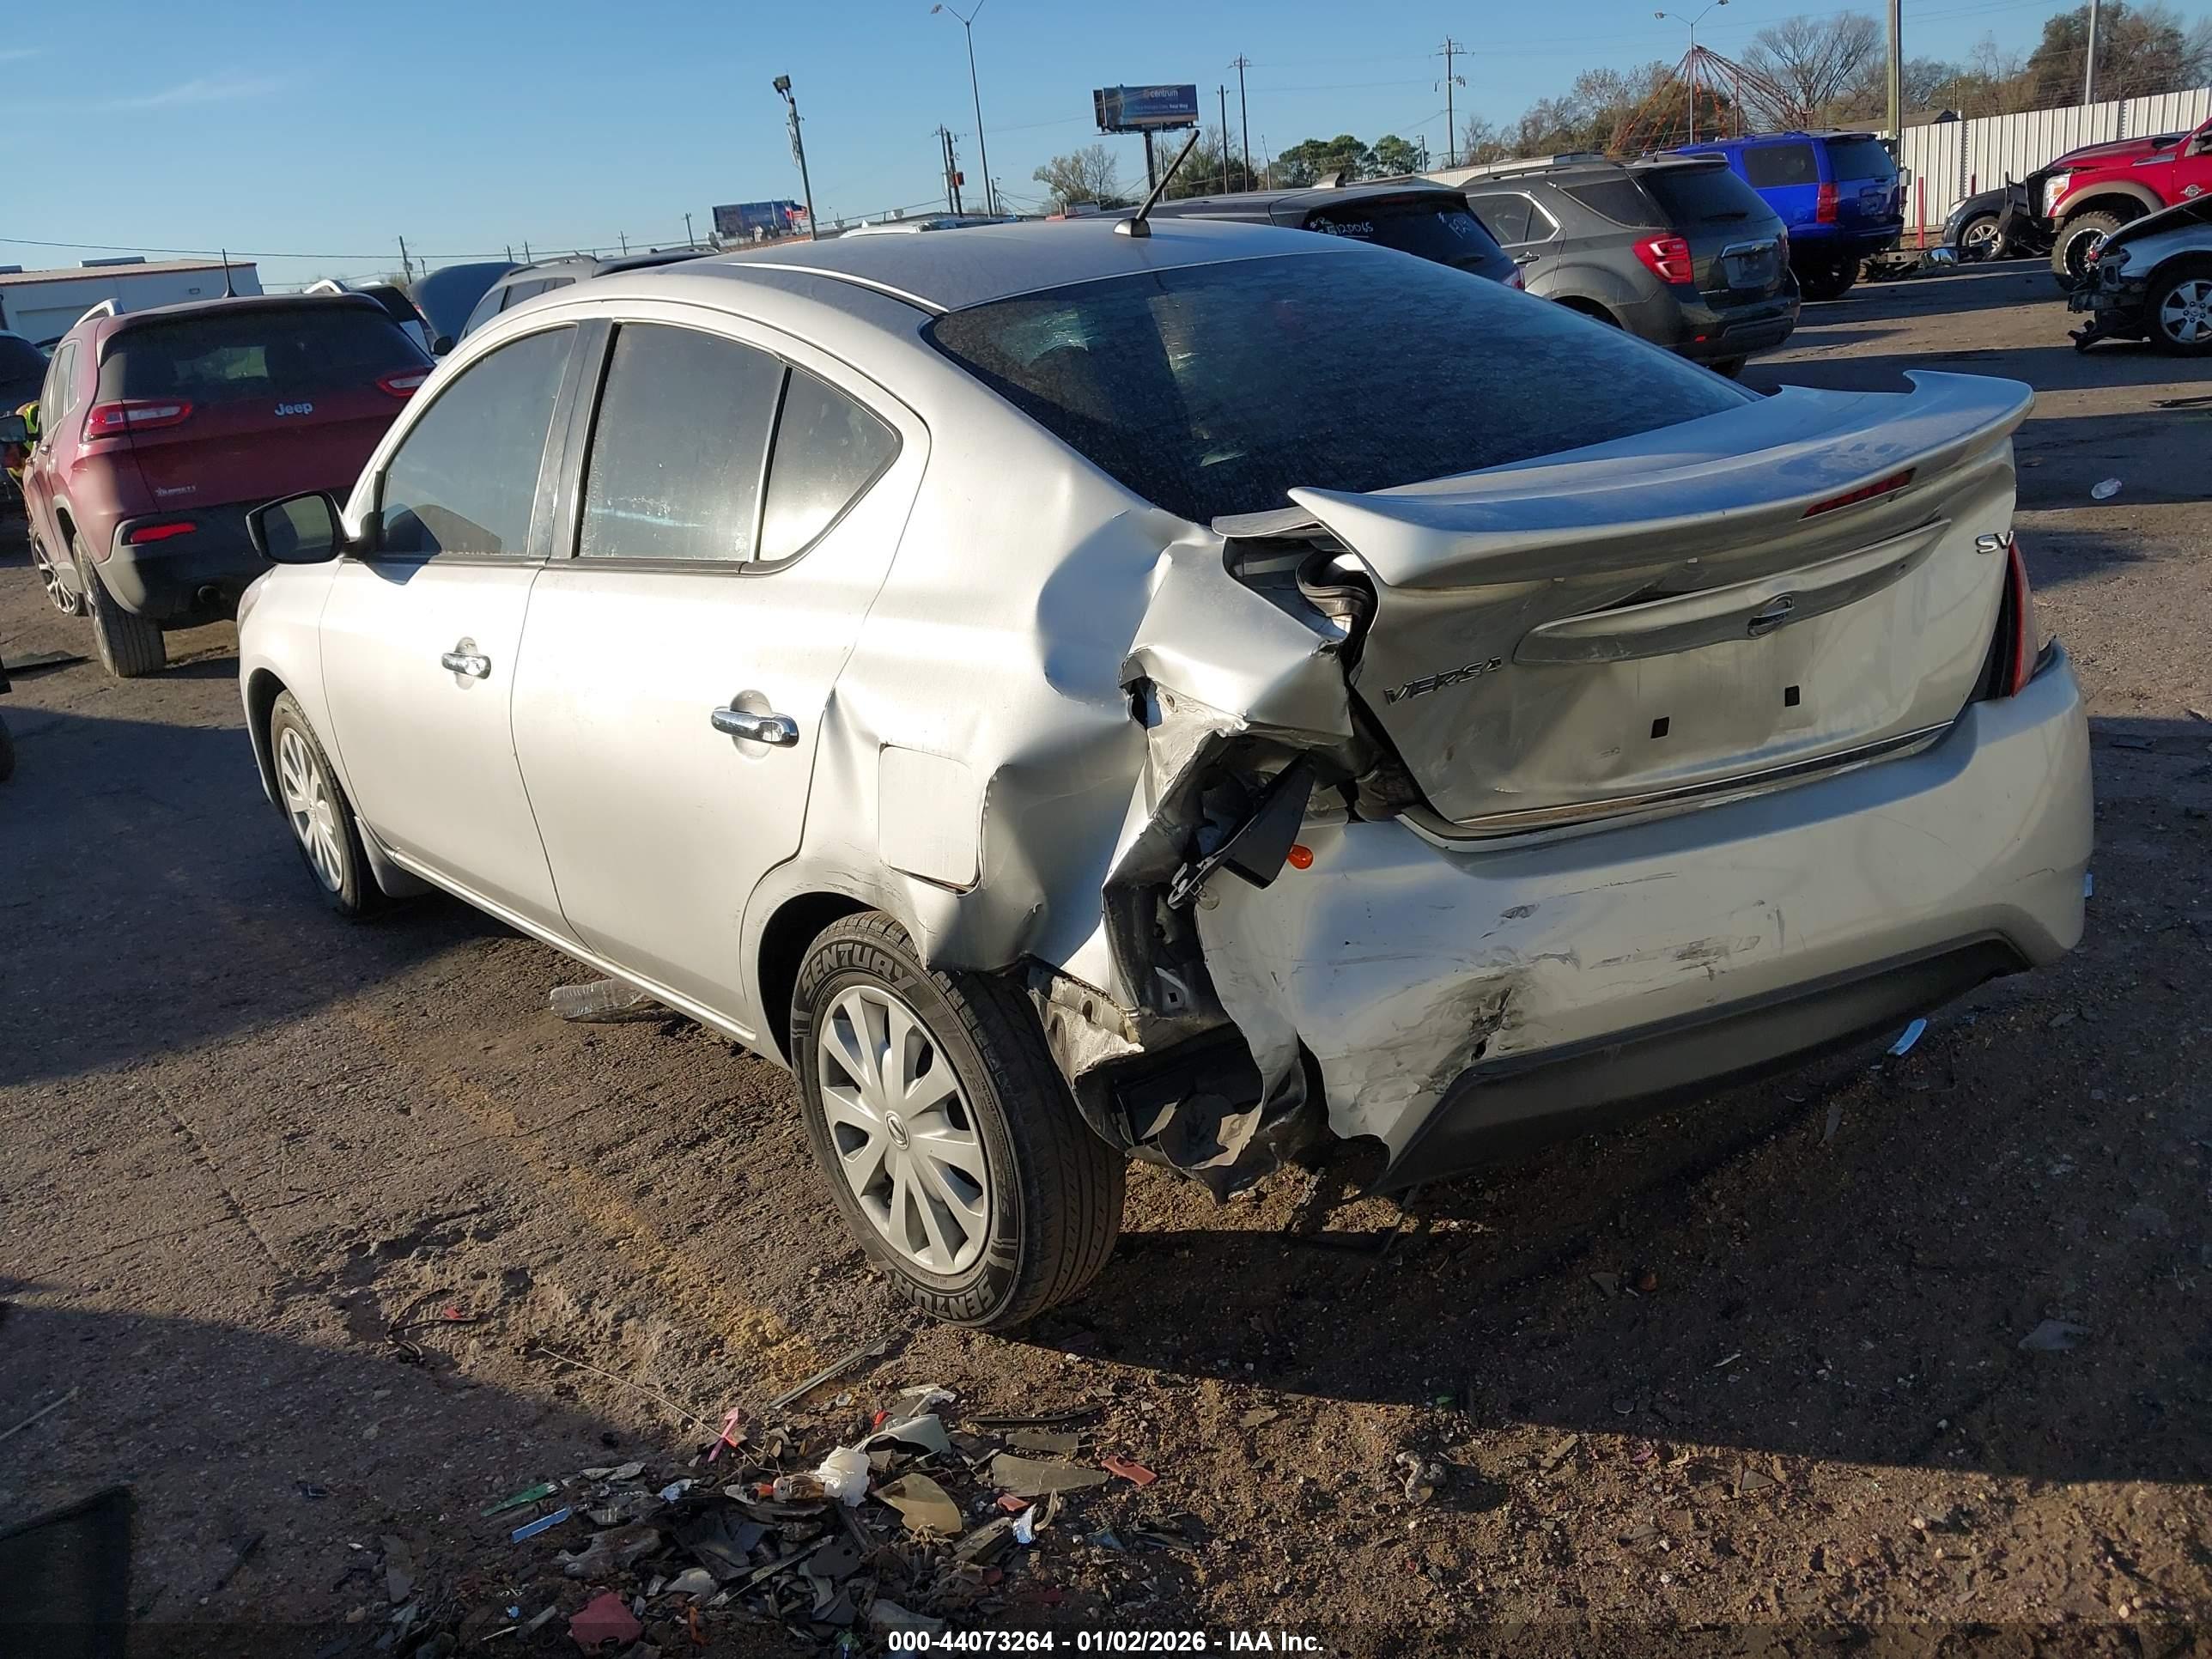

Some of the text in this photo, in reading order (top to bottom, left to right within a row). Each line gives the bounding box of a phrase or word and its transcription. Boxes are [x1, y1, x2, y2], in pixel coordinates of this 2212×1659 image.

[275, 402, 313, 416] Jeep
[1975, 530, 2014, 554] SV
[1383, 656, 1502, 705] VERSA
[801, 943, 917, 1001] SENTURY
